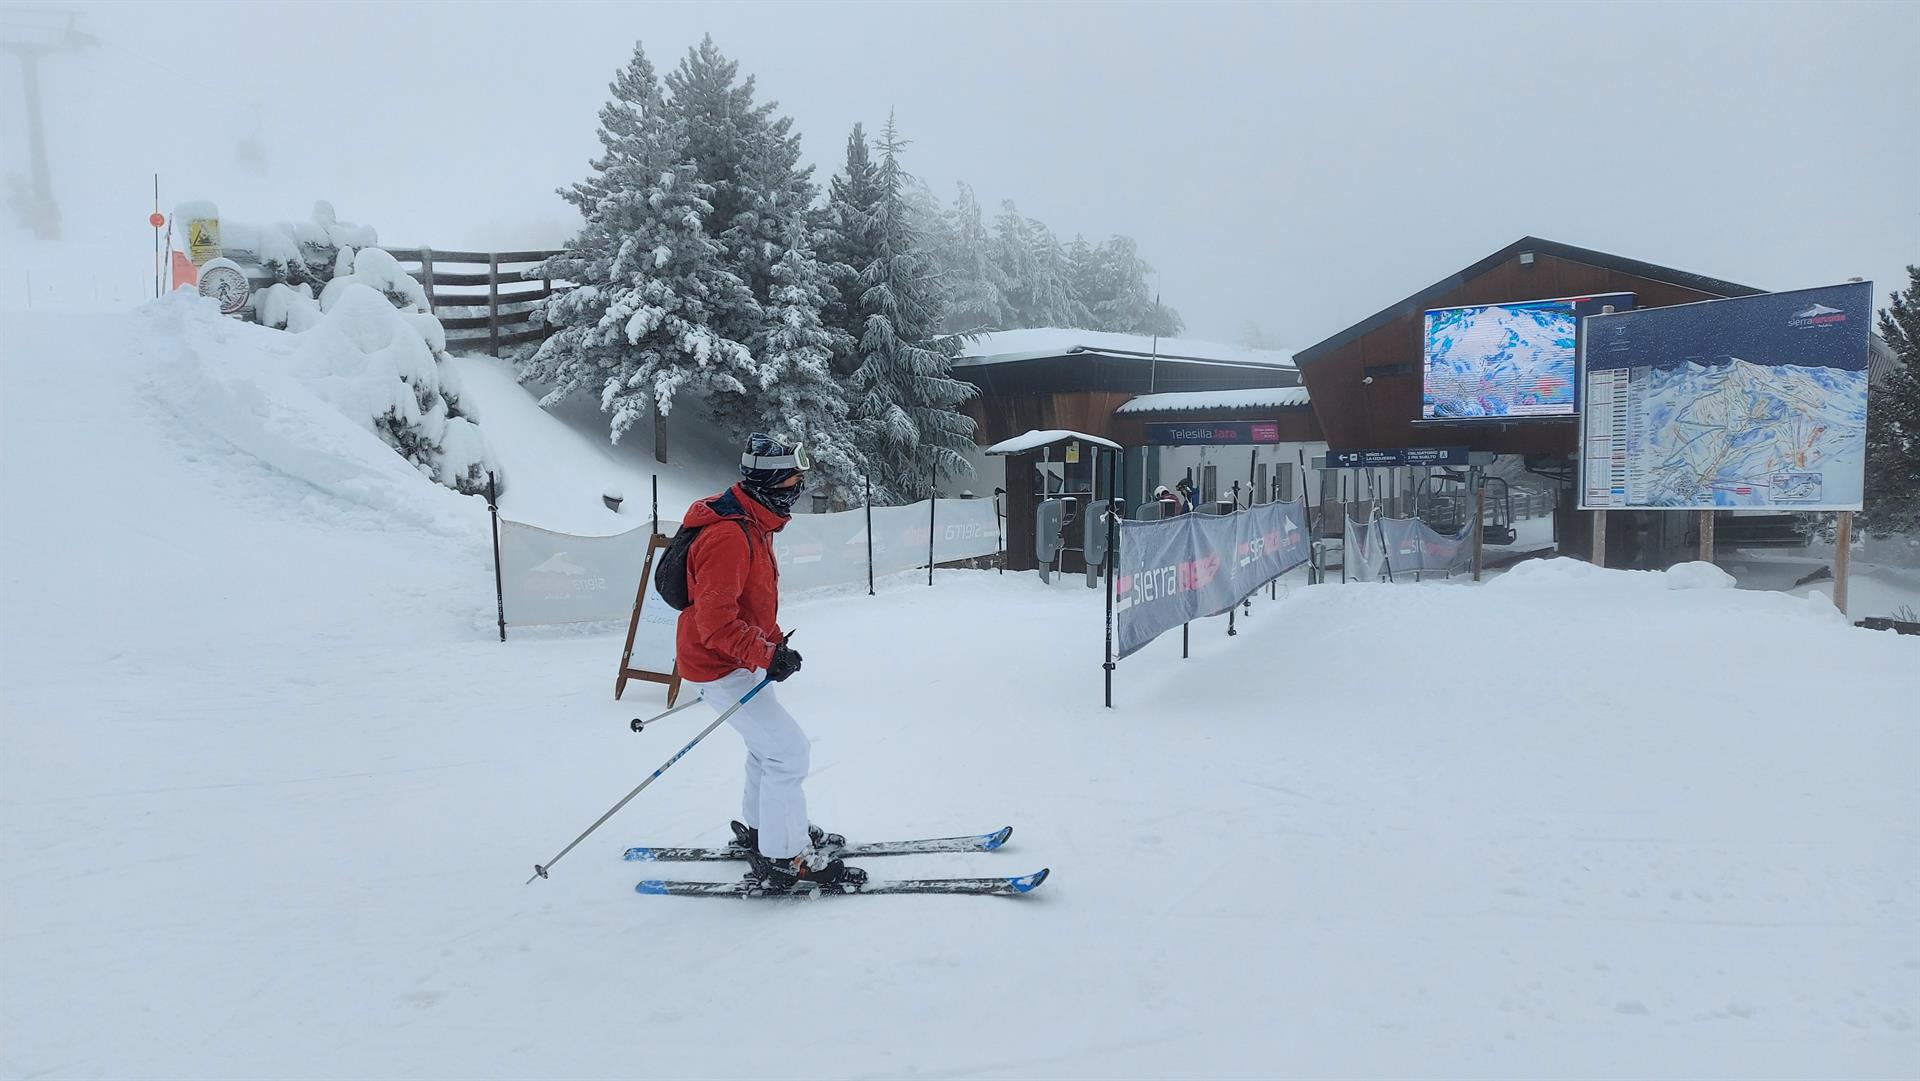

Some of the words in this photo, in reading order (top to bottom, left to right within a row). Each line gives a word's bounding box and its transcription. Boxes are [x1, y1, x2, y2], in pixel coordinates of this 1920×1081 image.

[1787, 318, 1813, 328] sierra
[1169, 428, 1212, 439] Telesilla
[1133, 562, 1177, 605] sierra
